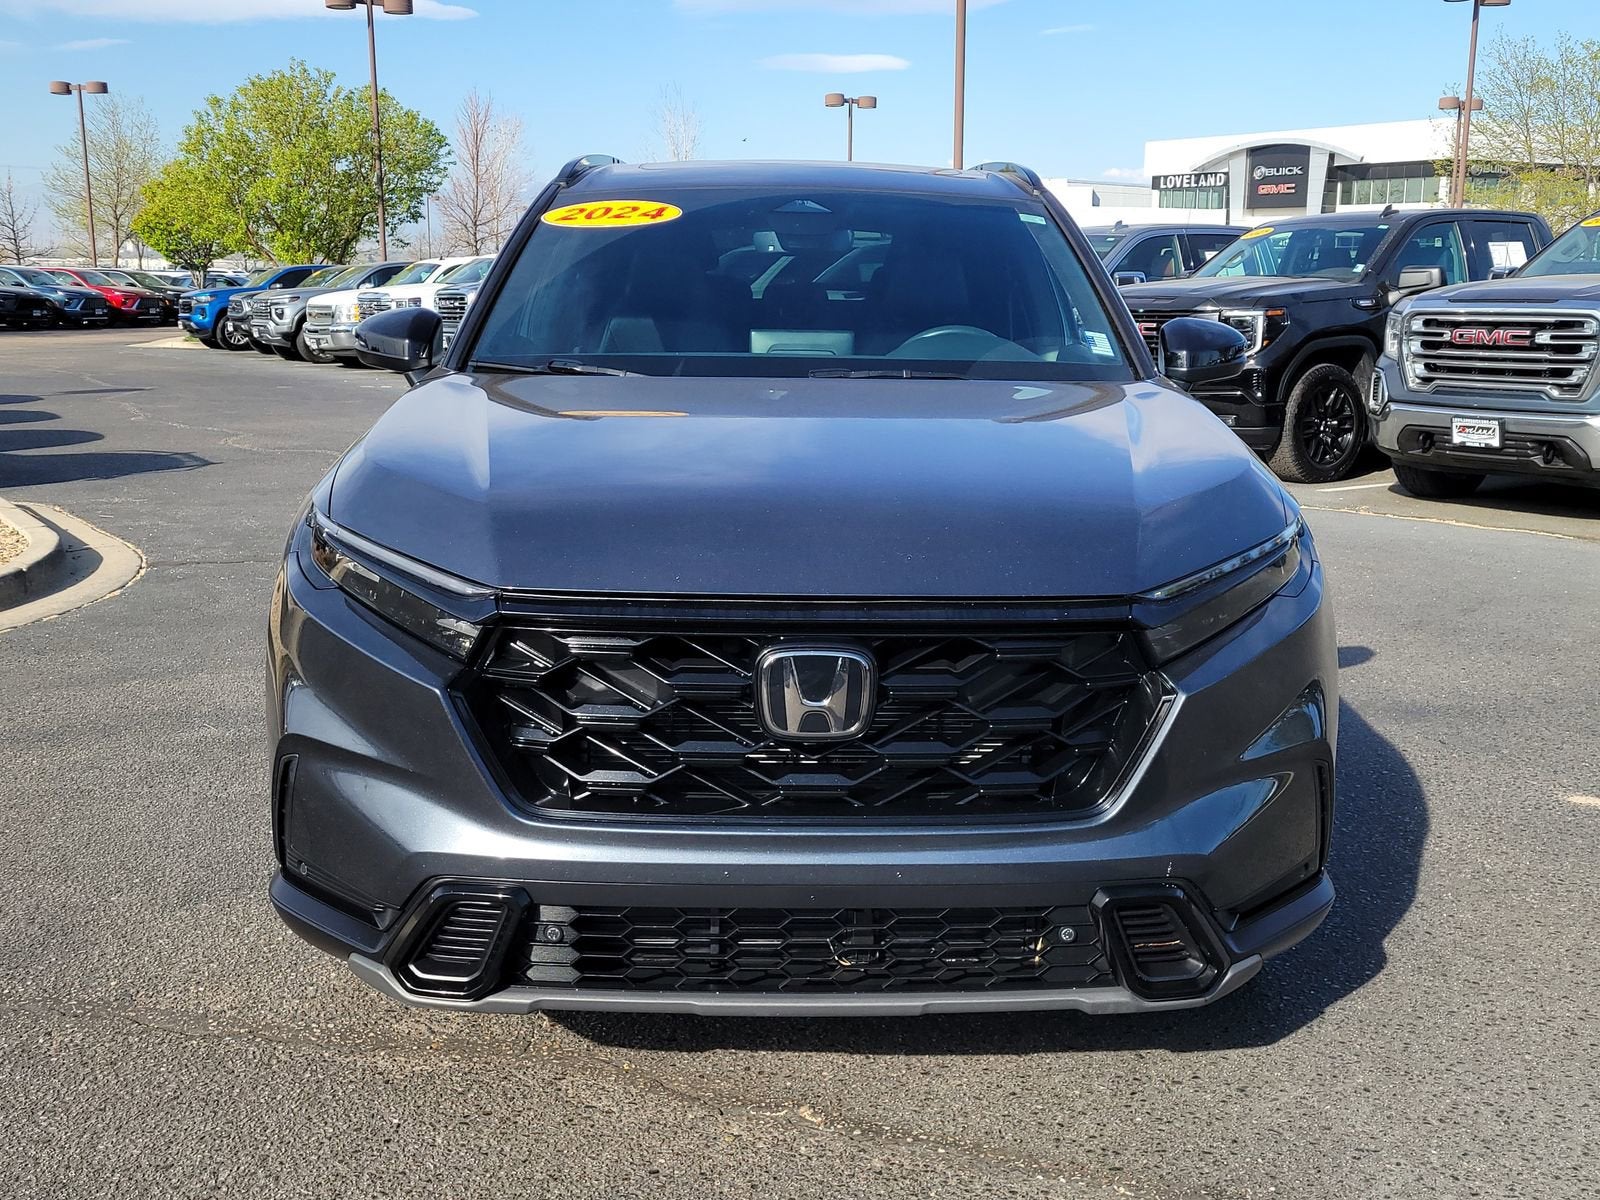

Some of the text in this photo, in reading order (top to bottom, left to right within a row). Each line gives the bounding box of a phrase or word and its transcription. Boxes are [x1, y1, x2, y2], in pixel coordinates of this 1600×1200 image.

[1265, 166, 1303, 176] BUICK
[1160, 173, 1225, 188] LOVELAND
[1257, 183, 1296, 195] GMC
[554, 206, 669, 222] 2024
[1452, 328, 1531, 347] GMC
